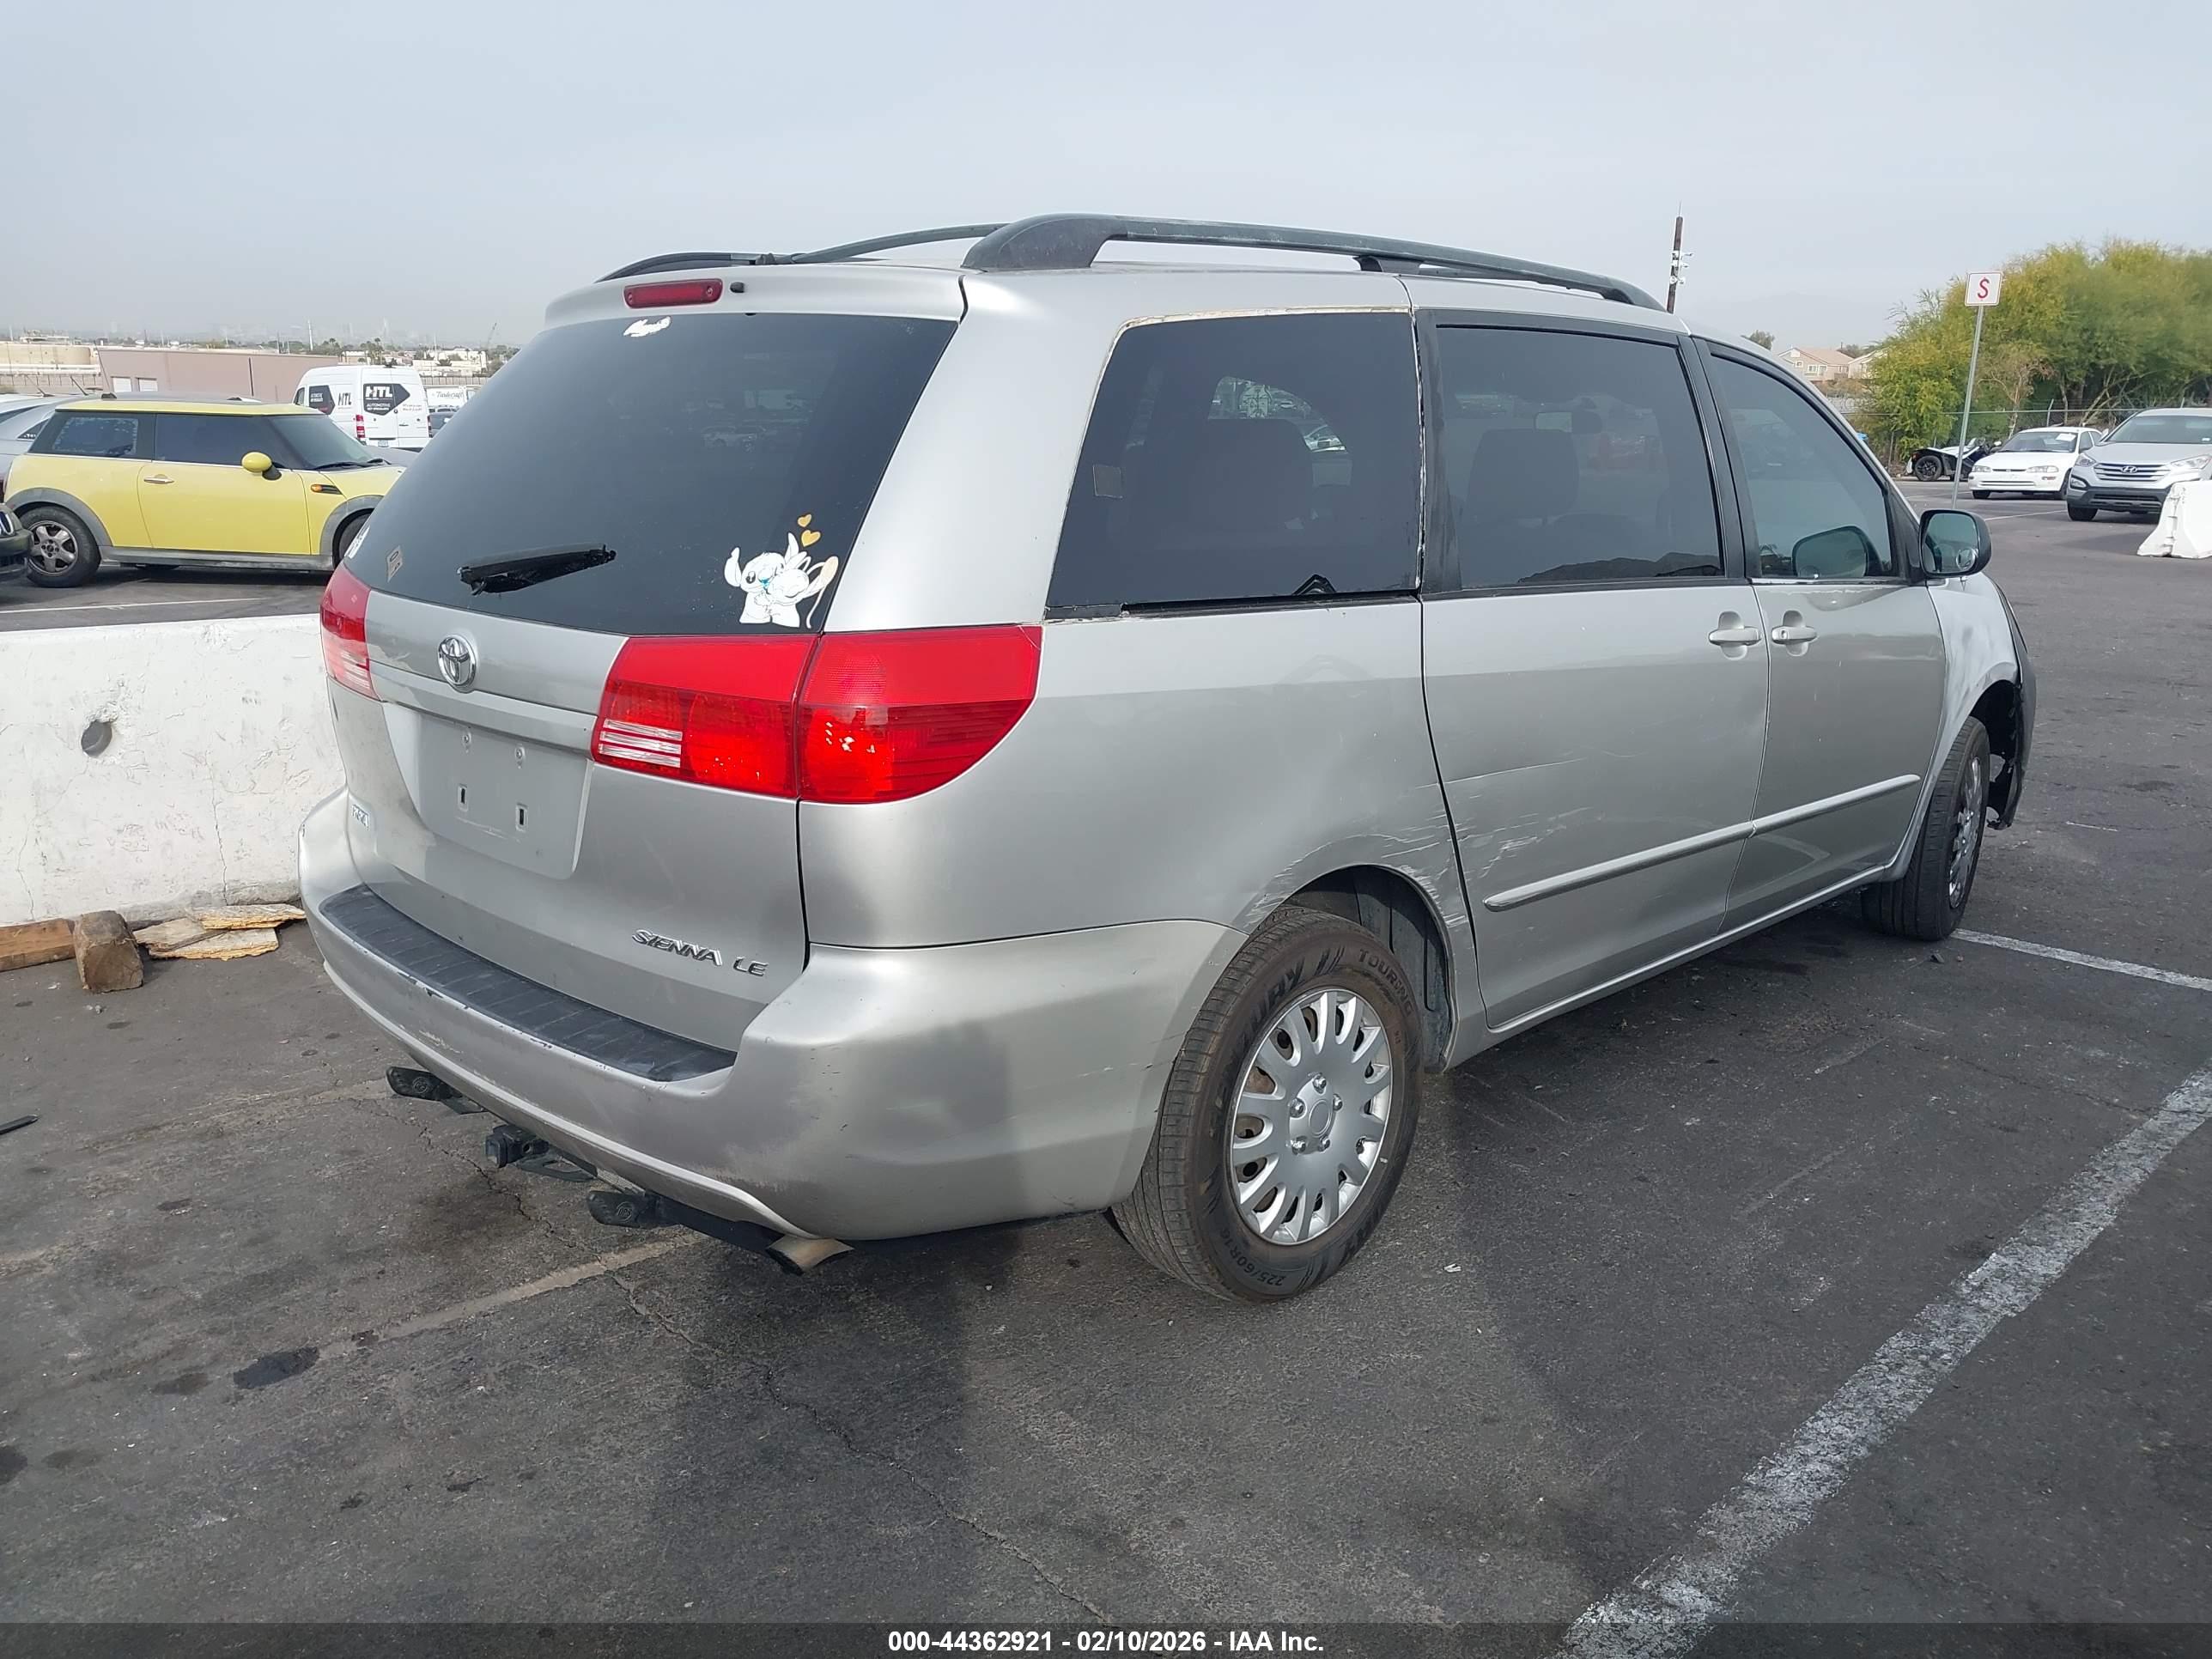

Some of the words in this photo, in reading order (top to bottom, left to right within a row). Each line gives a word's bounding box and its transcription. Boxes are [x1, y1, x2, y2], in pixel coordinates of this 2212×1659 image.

[1978, 277, 1990, 299] S
[338, 392, 352, 405] HTL
[365, 386, 393, 398] HTL
[632, 929, 723, 966] SIENNA
[733, 956, 769, 976] LE
[1358, 948, 1413, 1016] TOURING
